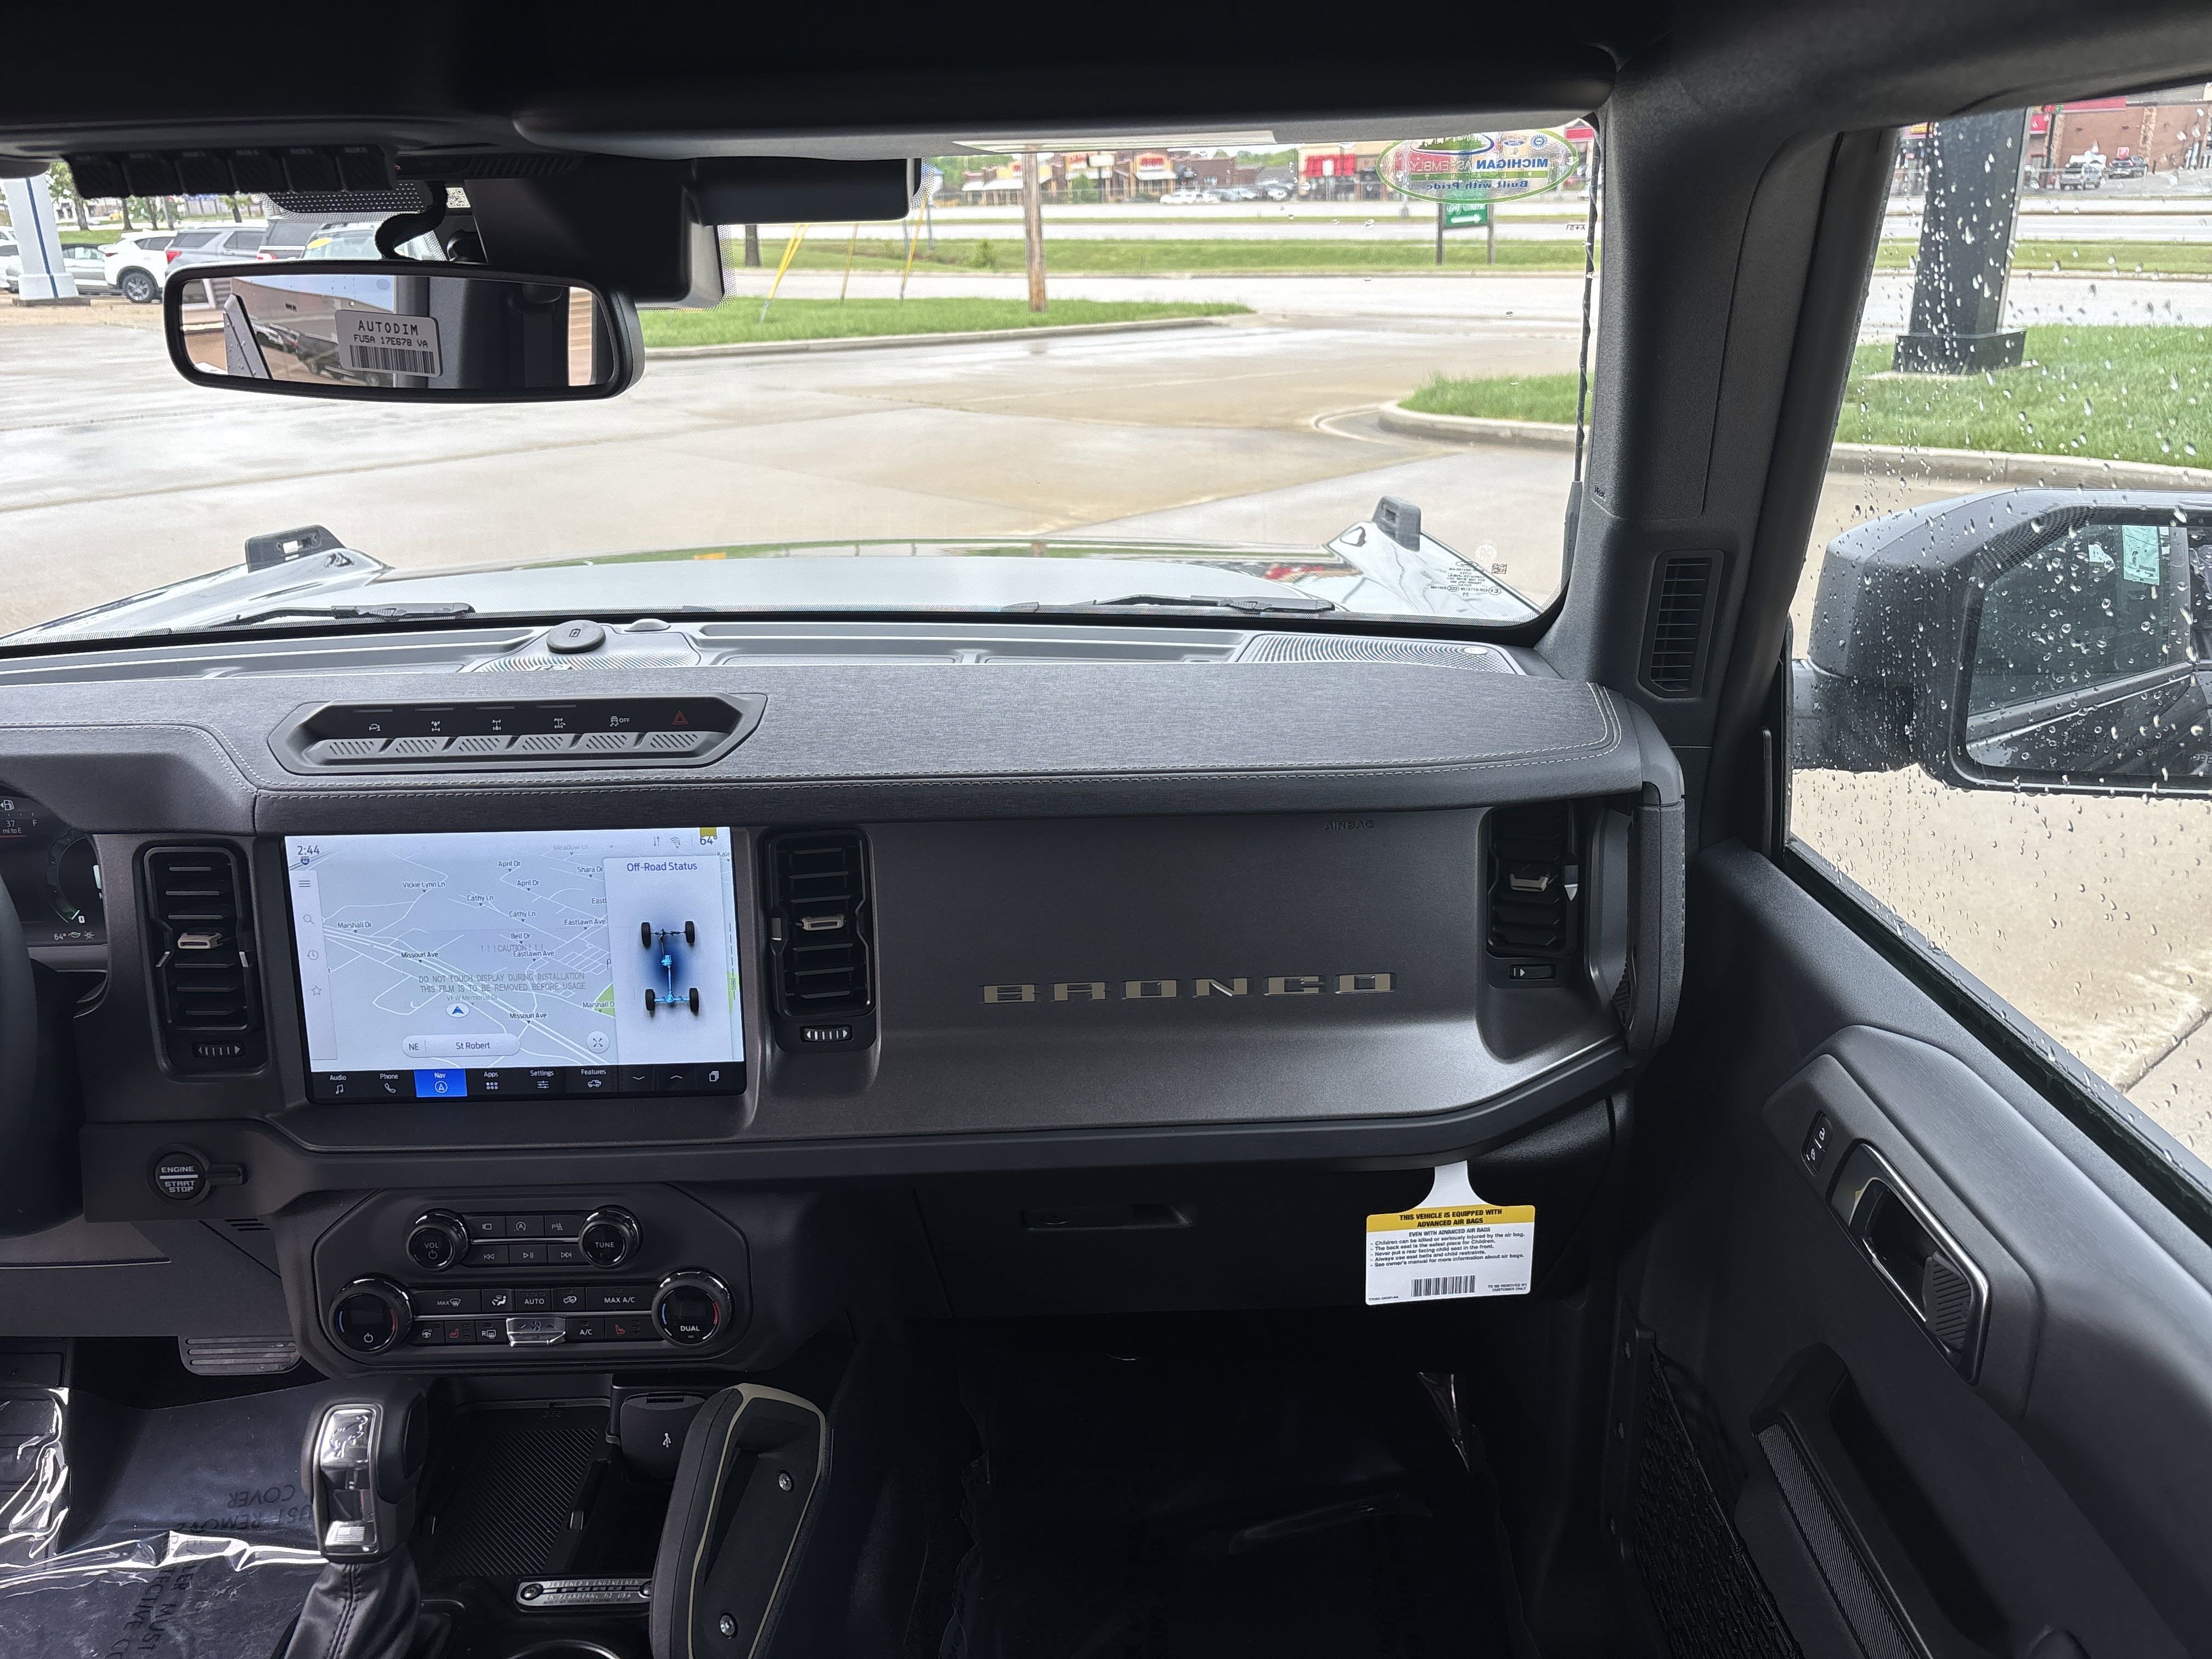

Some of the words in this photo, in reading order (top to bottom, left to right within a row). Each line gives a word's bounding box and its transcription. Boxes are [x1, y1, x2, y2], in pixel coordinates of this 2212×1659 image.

[358, 320, 418, 336] AUTODIM
[381, 337, 412, 346] 17E678
[417, 340, 428, 348] VA
[1324, 819, 1374, 830] AIRBAG
[297, 845, 320, 855] 2:44
[627, 862, 667, 871] Off-Road
[669, 862, 697, 871] Status
[537, 972, 585, 980] INSTALLATION
[982, 972, 1396, 1004] BRONCO
[227, 1484, 296, 1508] COVER
